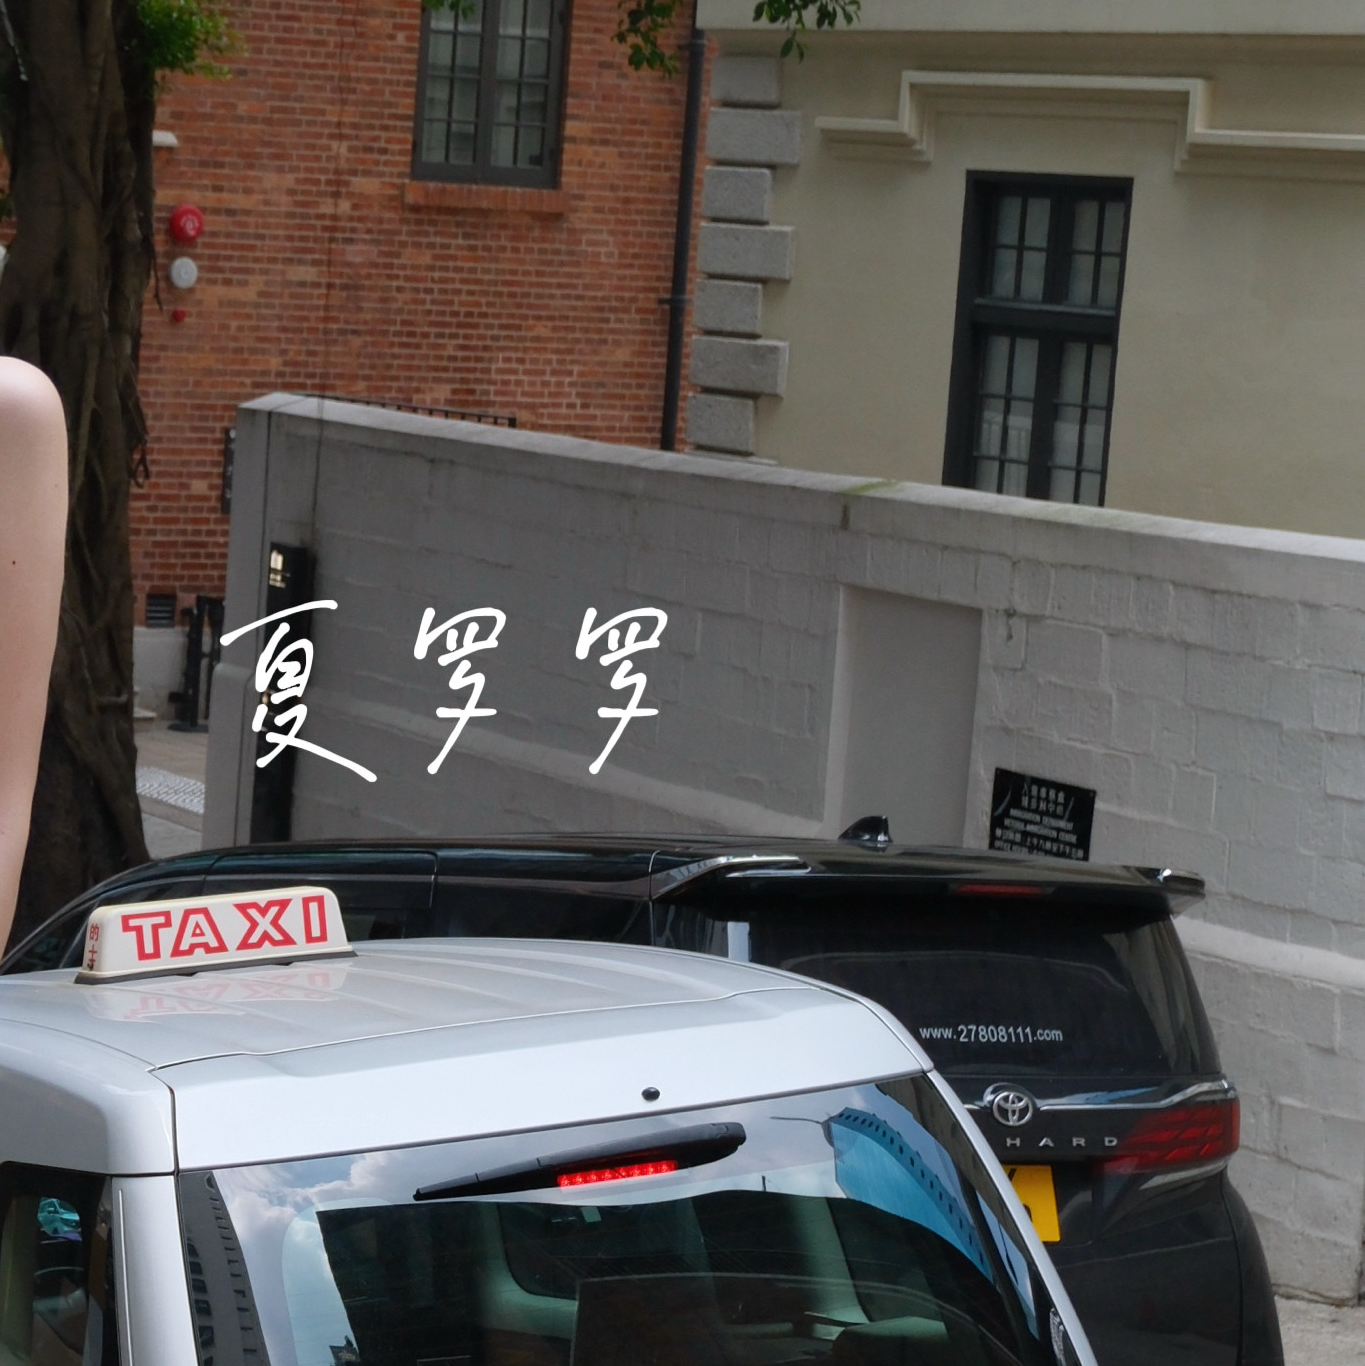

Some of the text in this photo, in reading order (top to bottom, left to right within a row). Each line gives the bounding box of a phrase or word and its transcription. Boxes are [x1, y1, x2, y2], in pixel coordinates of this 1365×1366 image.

[121, 895, 328, 961] TAXI
[919, 1024, 1064, 1044] www.27808111.com
[1006, 1137, 1118, 1150] HARD
